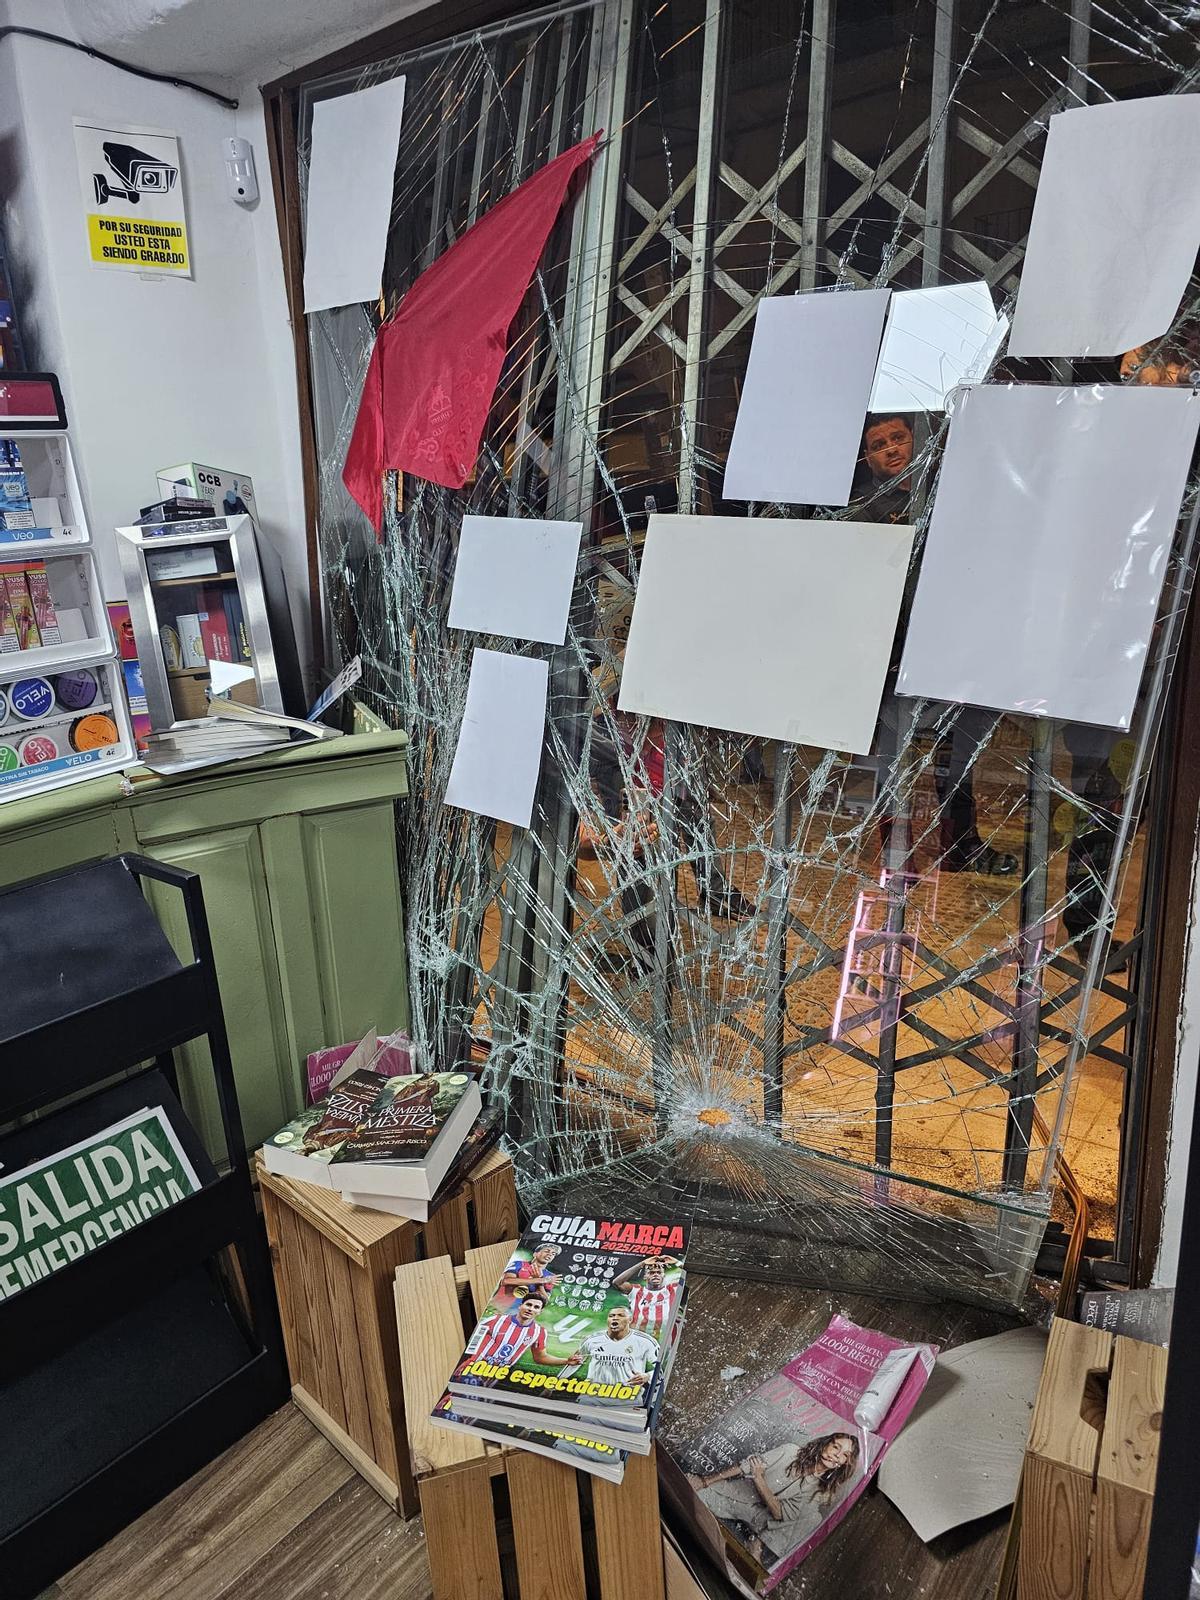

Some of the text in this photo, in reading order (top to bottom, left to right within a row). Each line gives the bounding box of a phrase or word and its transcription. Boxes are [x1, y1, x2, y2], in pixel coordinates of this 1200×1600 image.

[99, 220, 182, 237] POR SU SEGURIDAD
[114, 234, 171, 250] USTED ESTA
[102, 246, 185, 264] SIENDO GRABADO
[198, 472, 221, 487] OCB
[15, 685, 50, 710] VELO
[28, 740, 48, 763] ELO
[65, 753, 92, 767] VELO
[0, 773, 18, 782] OTINA
[378, 1105, 432, 1117] PRIMERA
[363, 1113, 437, 1128] MESTIZA
[0, 1129, 173, 1256] SALIDA
[0, 1178, 186, 1297] EMERGENCIA
[531, 1214, 684, 1249] GUÍA MARCA
[541, 1233, 557, 1243] DE
[558, 1236, 573, 1245] LA
[573, 1238, 601, 1249] LIGA
[601, 1241, 663, 1255] 2025/2026
[841, 1336, 885, 1358] MIL GRACIAS
[594, 1353, 632, 1363] Emirates
[462, 1360, 509, 1380] ¡Qué
[509, 1368, 640, 1400] espectáculo!
